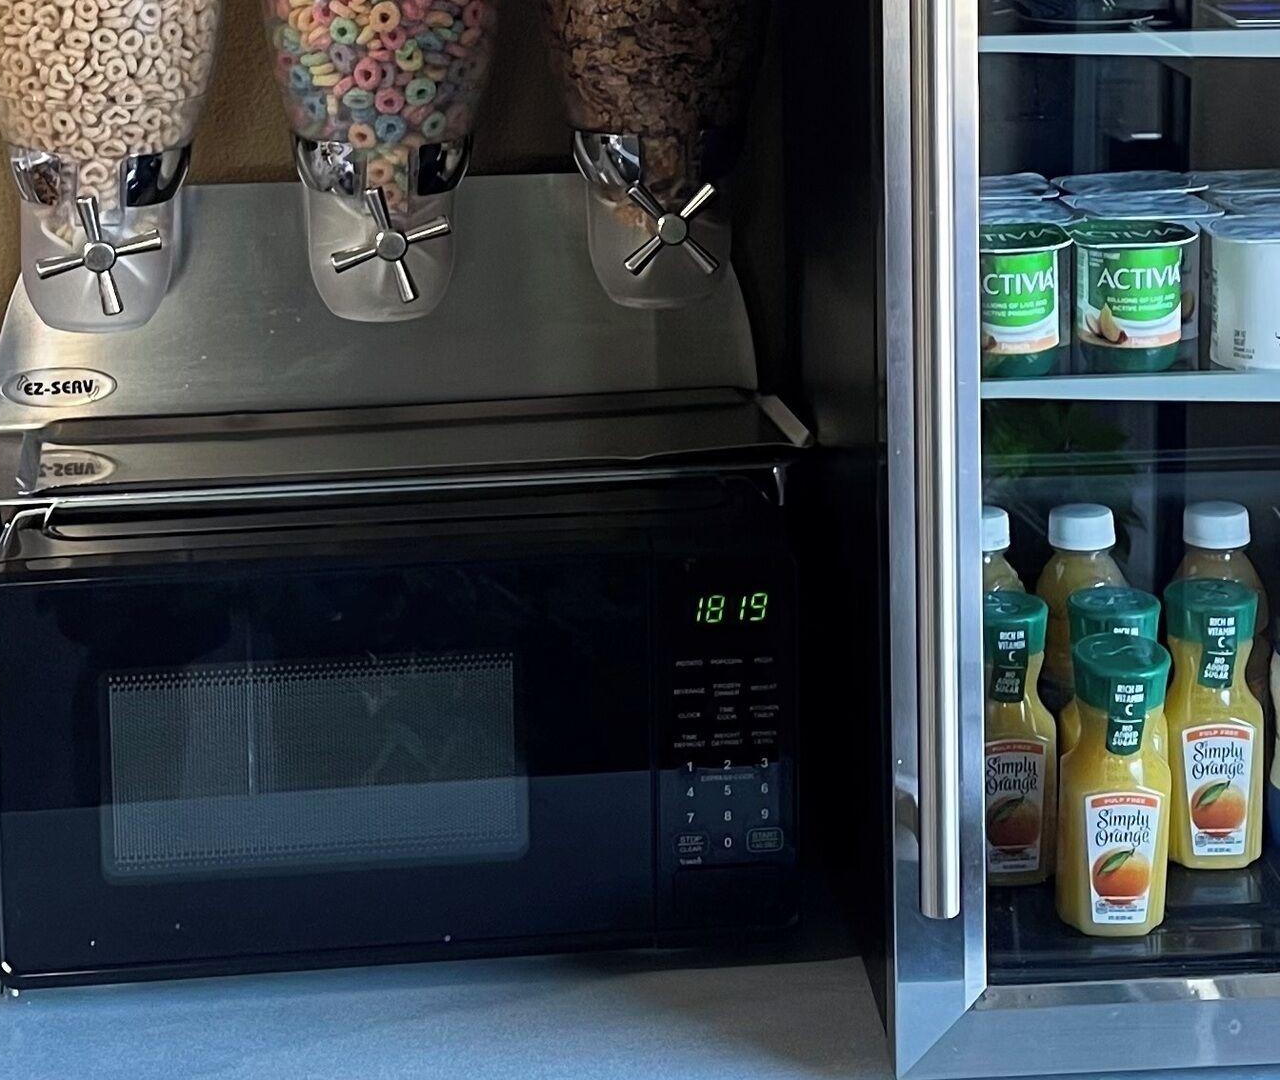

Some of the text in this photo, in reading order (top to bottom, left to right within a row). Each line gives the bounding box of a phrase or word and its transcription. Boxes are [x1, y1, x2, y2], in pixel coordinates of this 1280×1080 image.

[983, 267, 1055, 296] CTIVIA
[1097, 261, 1181, 290] ACTIVIA
[23, 379, 94, 397] EZ-SERV
[1210, 617, 1226, 626] RICH
[999, 631, 1016, 640] RICH
[1207, 626, 1236, 636] VITAMIN
[998, 640, 1026, 650] VITAMIN
[1218, 636, 1226, 649] C
[1008, 650, 1016, 662] C
[1214, 656, 1225, 664] NO
[1206, 662, 1230, 672] ADDED
[1204, 670, 1229, 680] SUGAR
[1117, 684, 1135, 694] RICH
[1115, 693, 1144, 703] VITAMIN
[1125, 703, 1133, 716] C
[1114, 730, 1139, 739] ADDED
[1112, 737, 1138, 746] SUGAR
[1193, 741, 1245, 763] Simply
[686, 757, 769, 772] 1 2 3
[986, 756, 1039, 777] Simply
[1192, 761, 1245, 780] Orange
[686, 782, 769, 798] 4 5 6
[986, 775, 1038, 796] Orange
[686, 808, 769, 823] 7 8 9
[1096, 808, 1151, 831] Simply
[680, 835, 703, 844] STOP
[724, 837, 732, 848] 0
[1095, 829, 1151, 848] Orange
